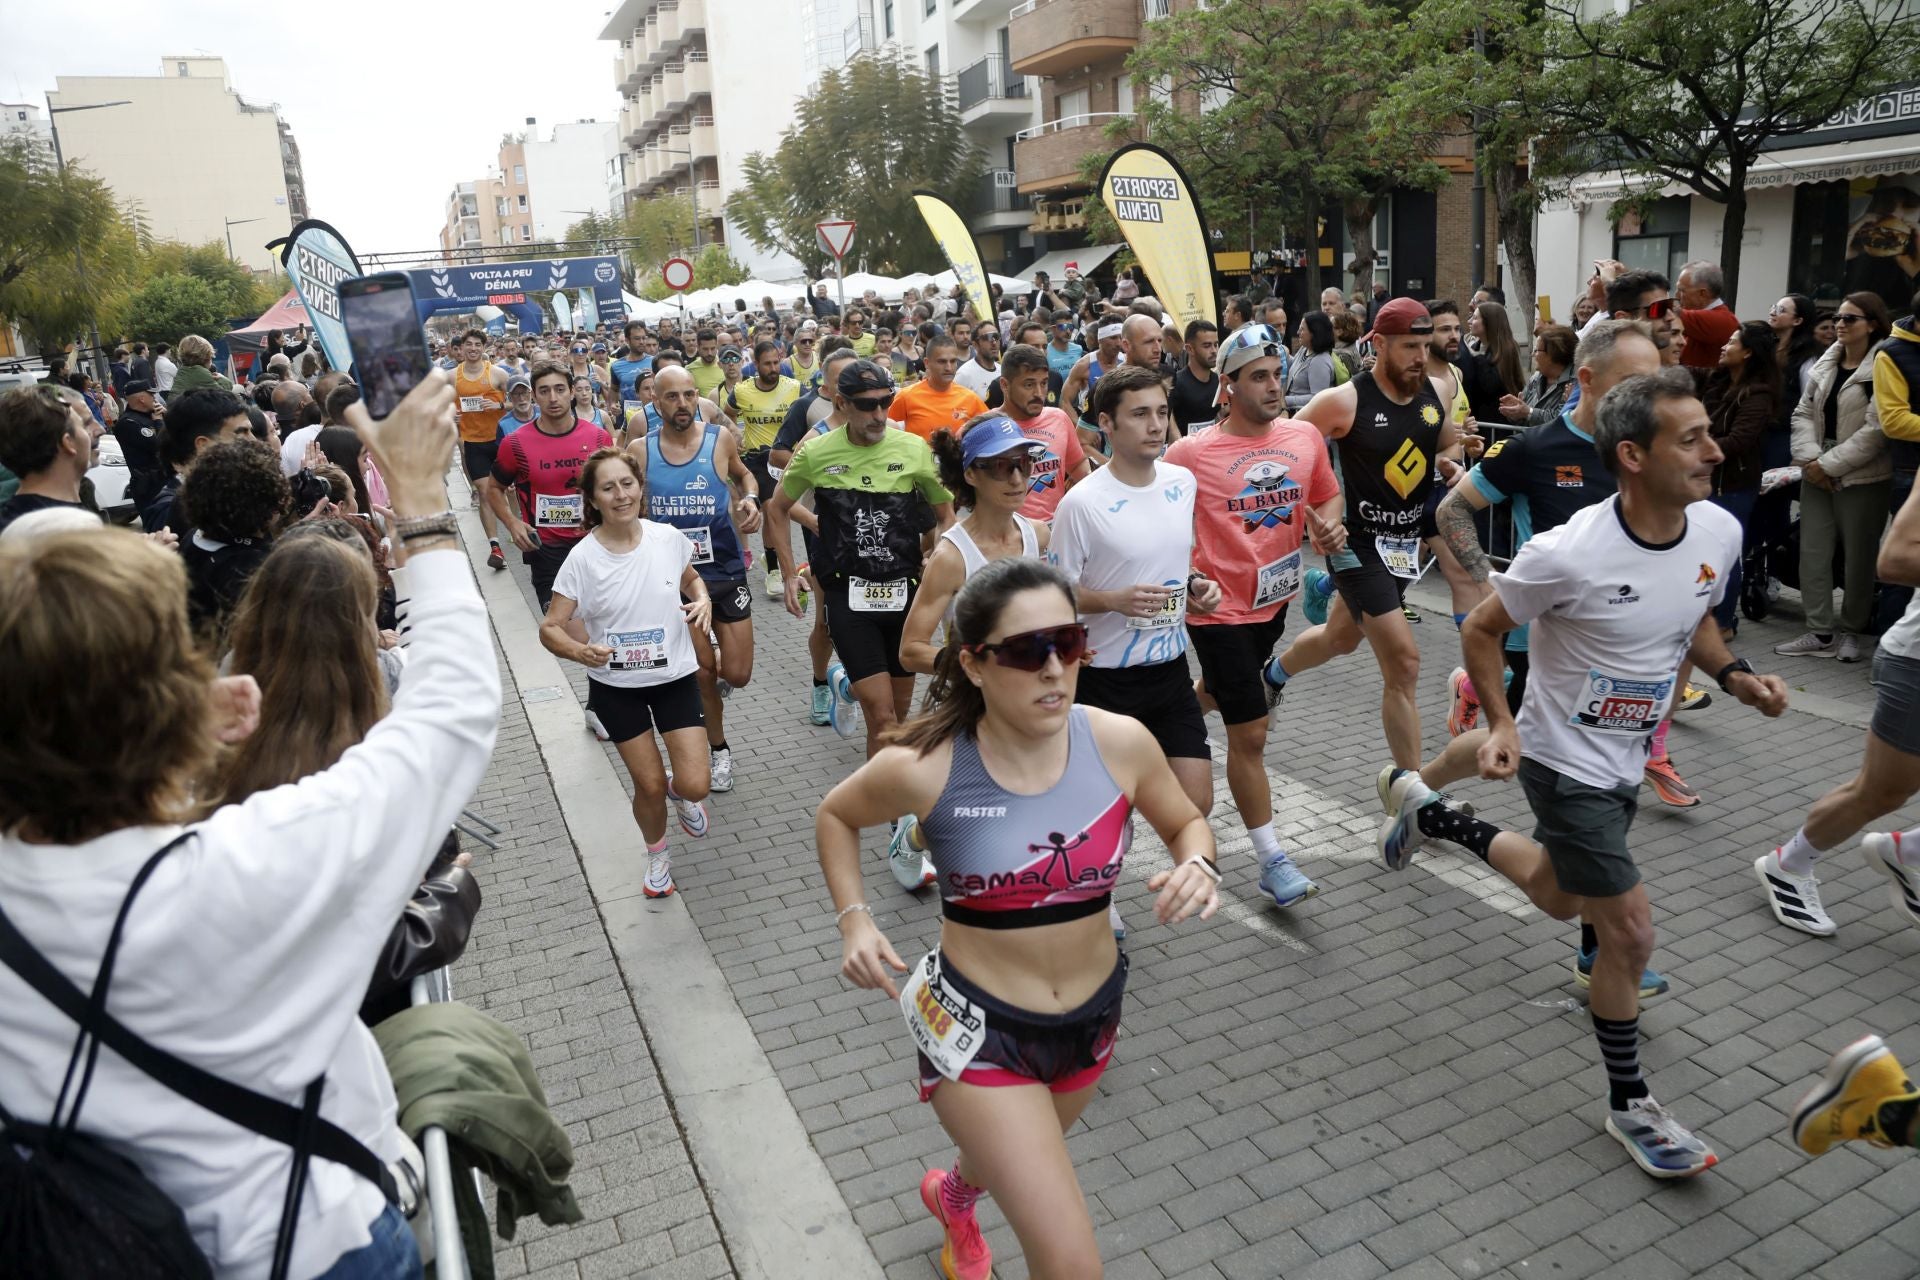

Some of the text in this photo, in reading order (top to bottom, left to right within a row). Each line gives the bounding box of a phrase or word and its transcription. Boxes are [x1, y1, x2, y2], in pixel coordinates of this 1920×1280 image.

[1744, 174, 1782, 186] BRADOR
[1793, 167, 1851, 181] PASTELERÍA
[1863, 159, 1920, 174] CAFETERÍA
[470, 268, 532, 280] VOLTA A PEU
[484, 280, 520, 290] DÉNIA
[746, 416, 783, 424] BALEAR
[540, 460, 550, 470] la
[1227, 449, 1298, 475] TABERNA MARINERA
[652, 494, 715, 506] ATLETISMO
[1228, 498, 1250, 512] EL
[542, 510, 572, 518] S 1299
[652, 506, 715, 516] BENIDORM
[1272, 577, 1289, 592] 656
[866, 588, 892, 598] 3655
[1261, 587, 1267, 596] A
[1163, 598, 1176, 611] 43
[612, 648, 650, 662] F 282
[1588, 700, 1648, 718] C 1398
[1598, 718, 1642, 728] BALEARIA
[954, 806, 1006, 818] FASTER
